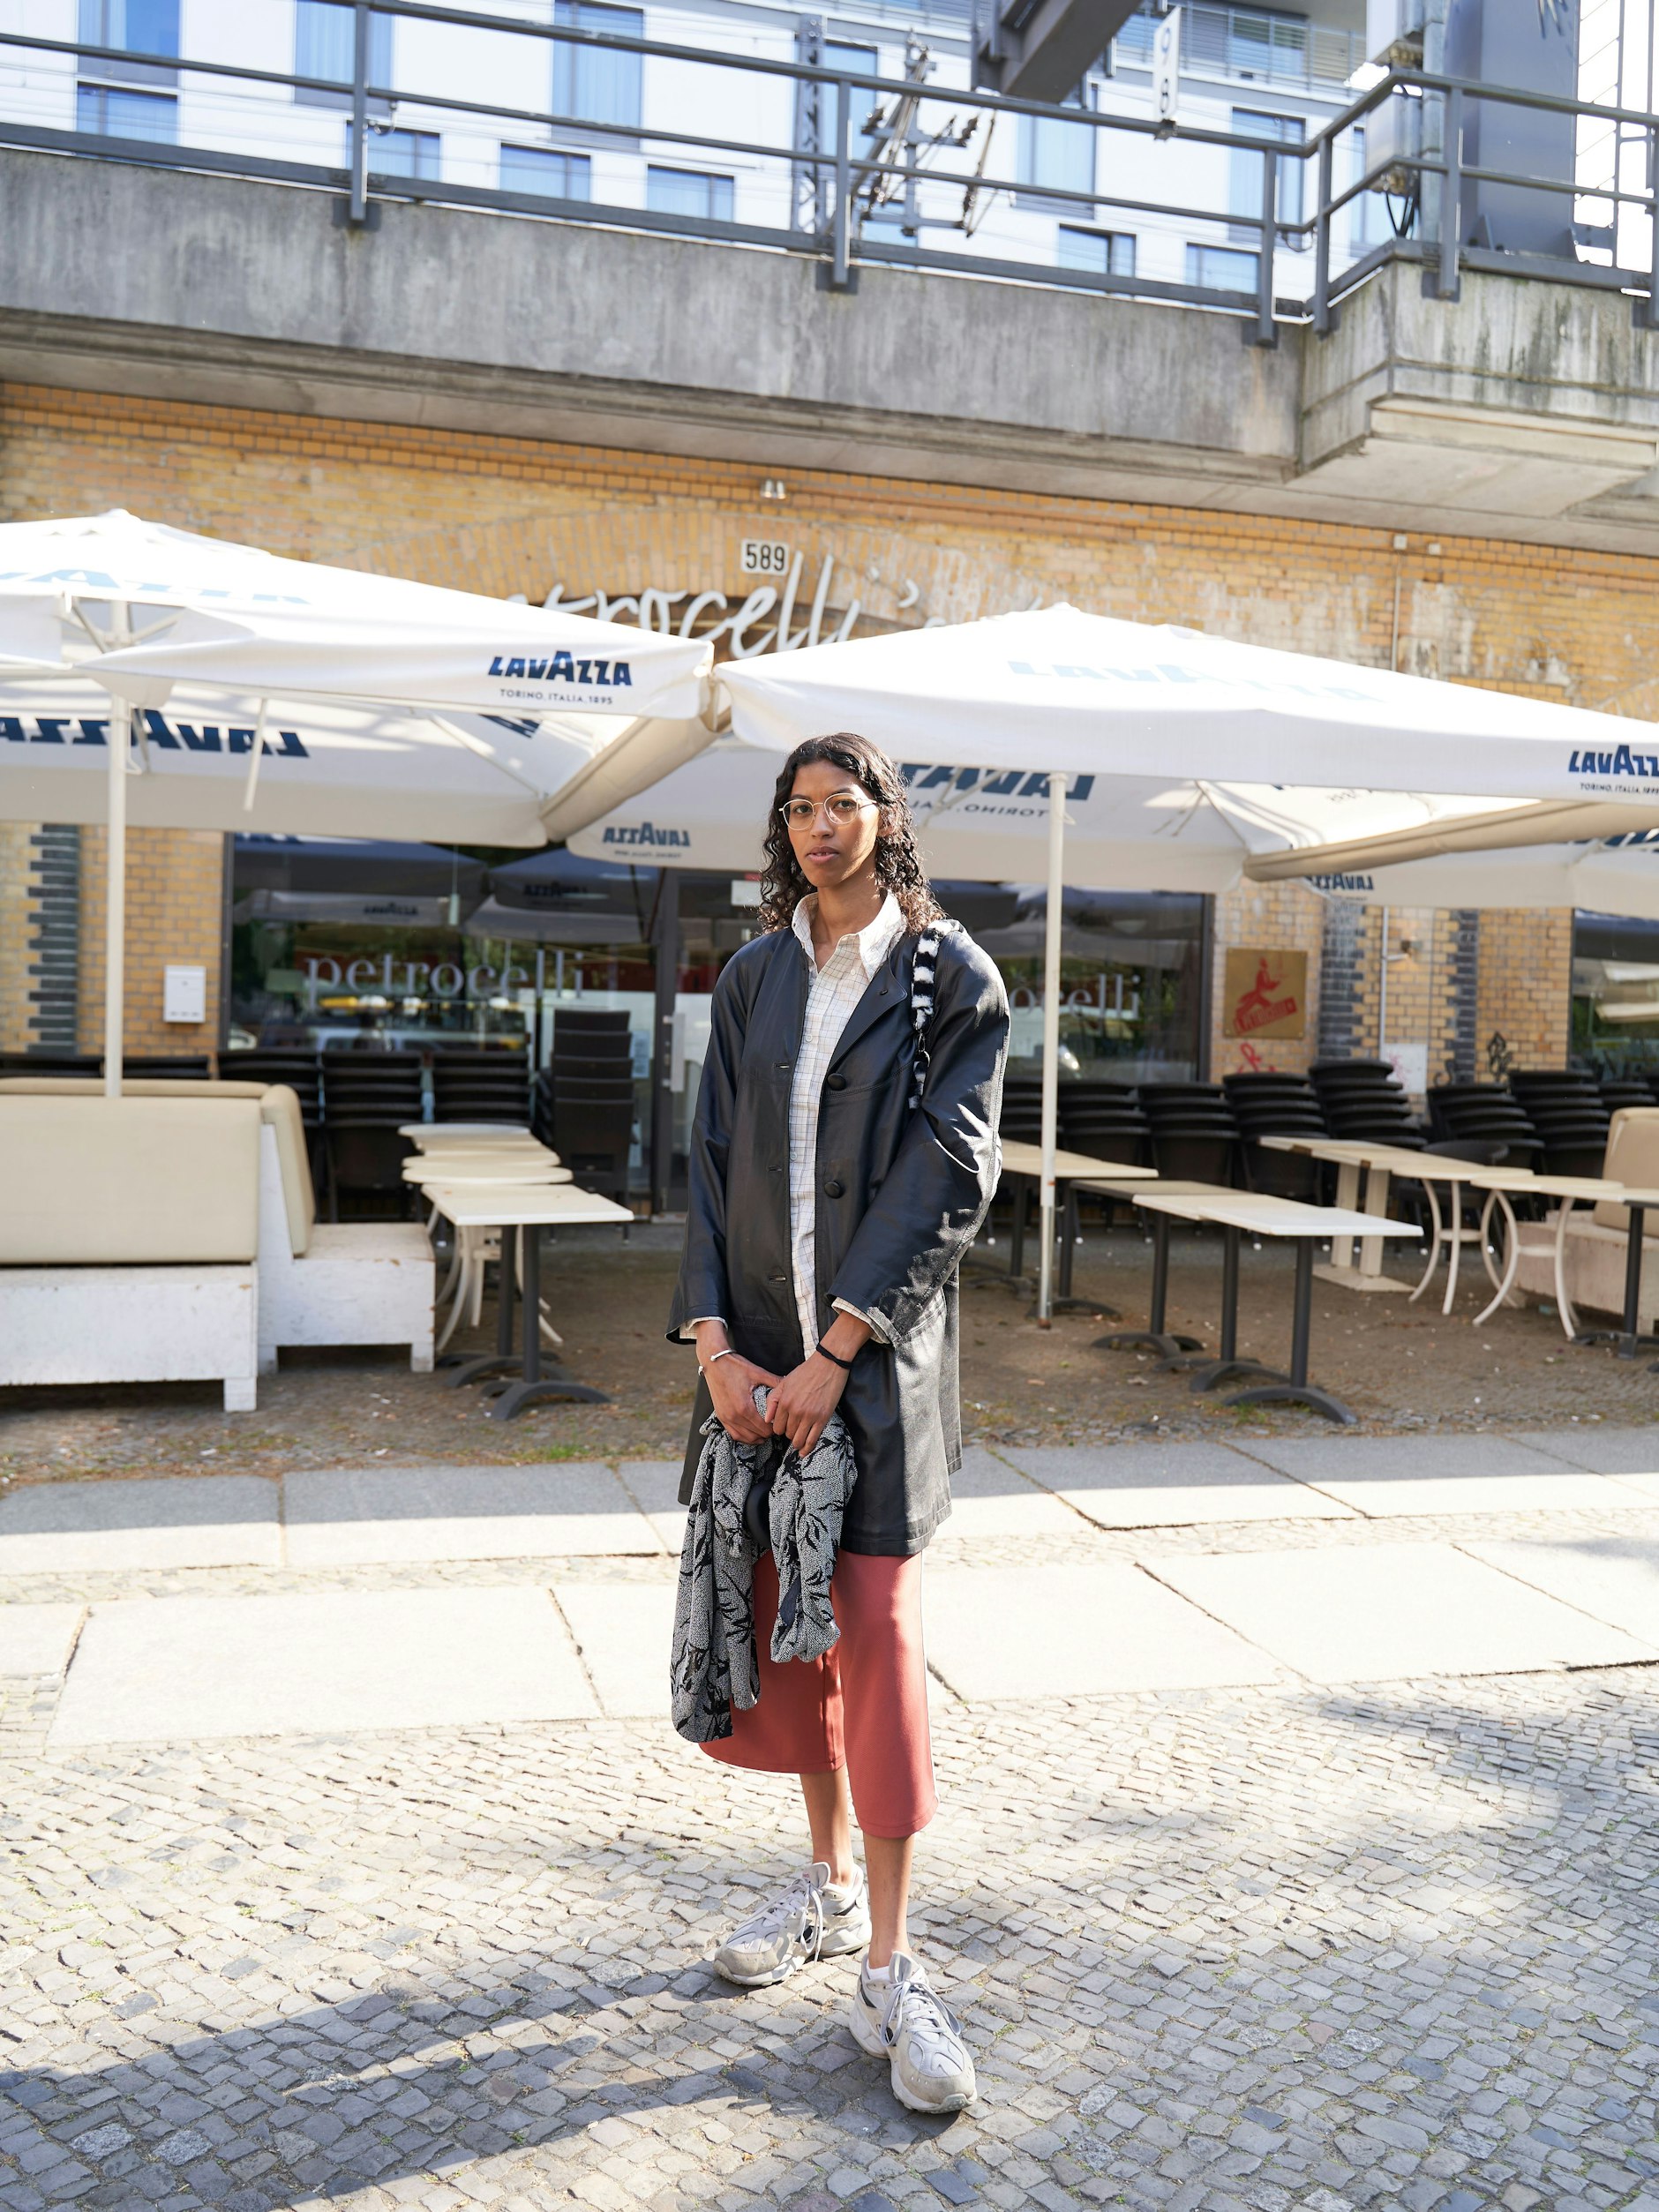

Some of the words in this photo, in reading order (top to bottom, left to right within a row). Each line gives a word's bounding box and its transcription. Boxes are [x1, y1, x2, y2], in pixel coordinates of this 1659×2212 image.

[747, 544, 784, 571] 589
[488, 650, 632, 686] LAVAZZA
[589, 695, 613, 705] 1895
[1568, 744, 1659, 776] LAVAZZ
[304, 949, 584, 1012] petrocelli
